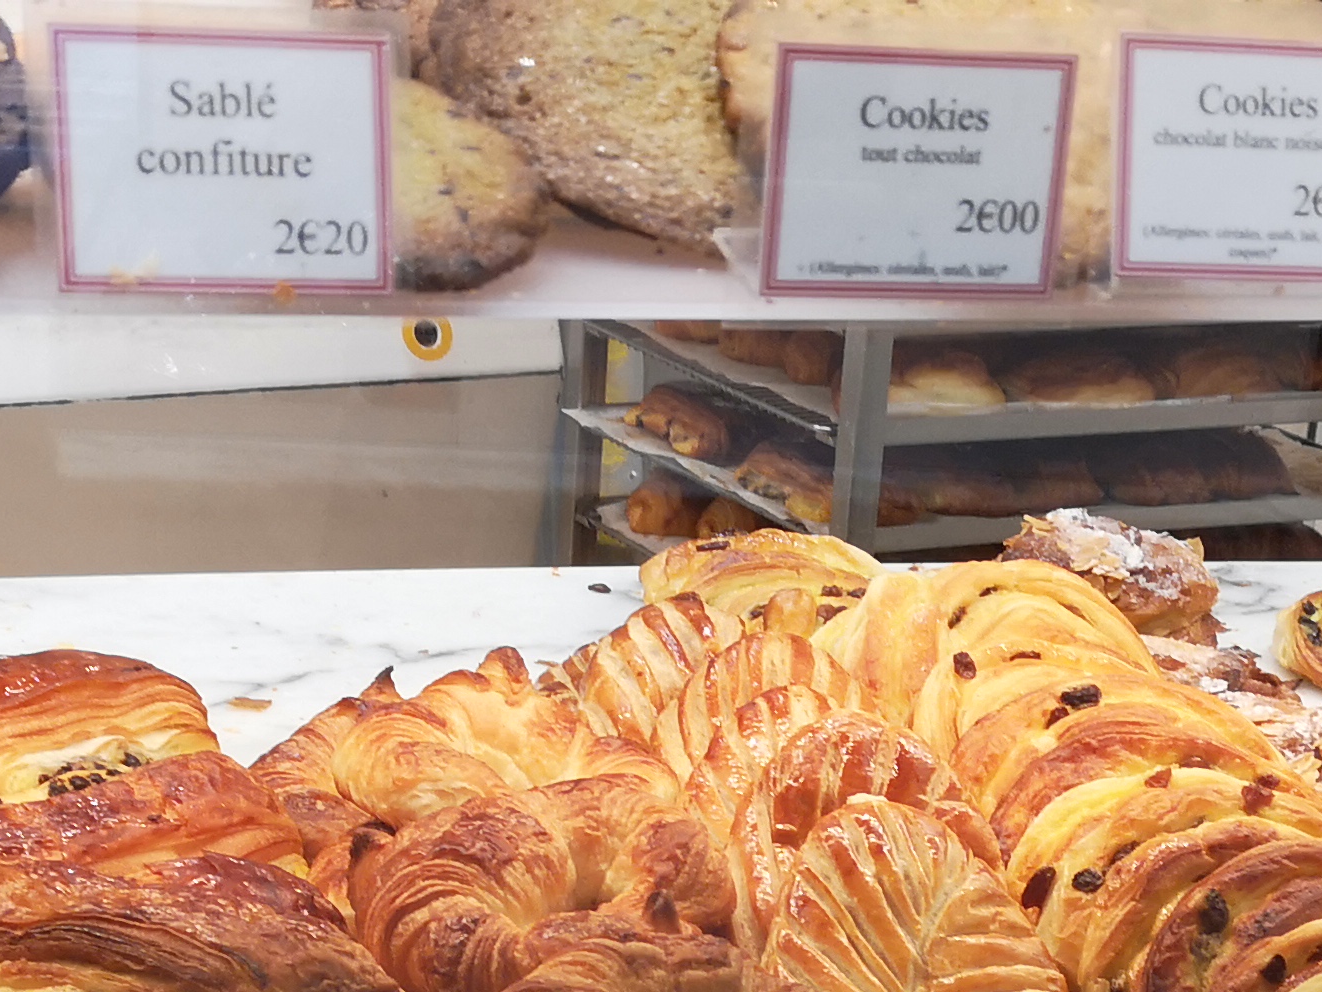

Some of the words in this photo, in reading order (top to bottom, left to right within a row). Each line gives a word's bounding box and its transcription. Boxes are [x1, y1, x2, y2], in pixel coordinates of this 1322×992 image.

[169, 80, 277, 119] Sablé
[860, 95, 990, 131] Cookies
[1198, 83, 1319, 119] Cookies
[861, 146, 899, 163] tout
[904, 144, 982, 165] chocolat
[1153, 127, 1227, 149] chocolat
[1233, 130, 1279, 151] blanc
[137, 140, 313, 178] confiture
[955, 198, 1040, 234] 2€00
[274, 219, 369, 256] 2€20
